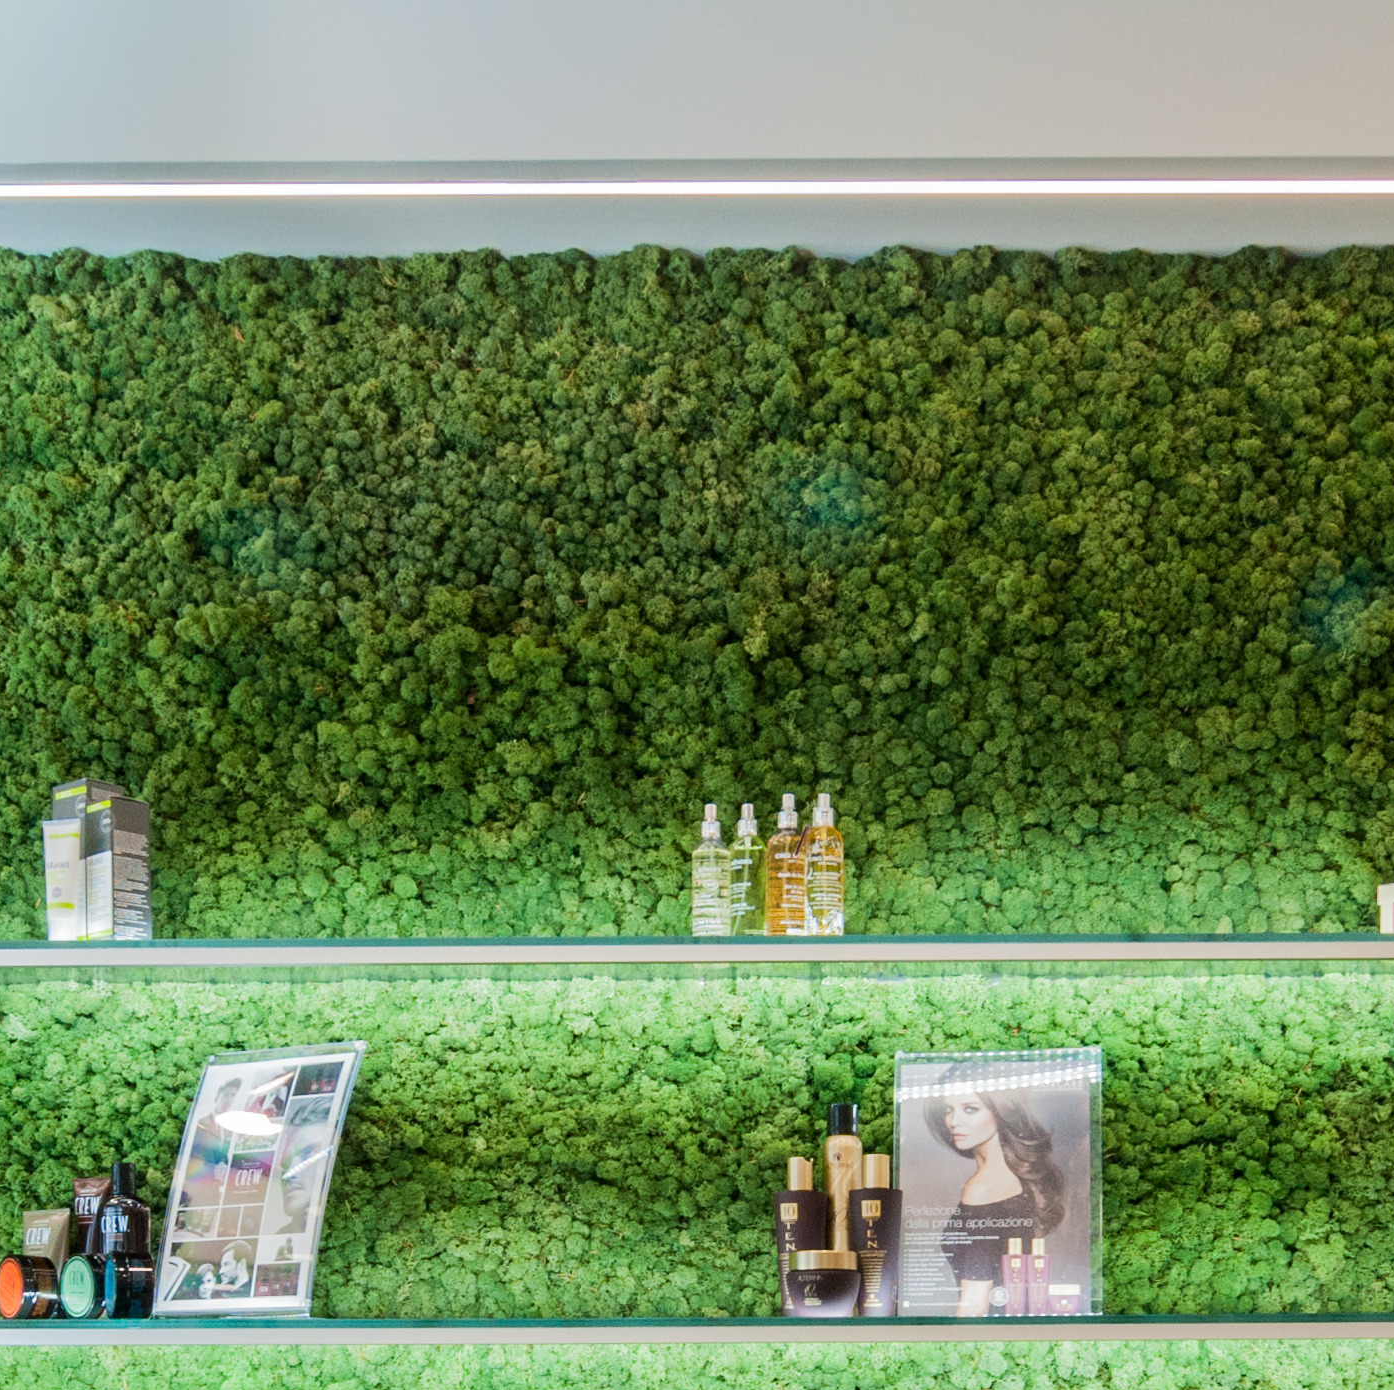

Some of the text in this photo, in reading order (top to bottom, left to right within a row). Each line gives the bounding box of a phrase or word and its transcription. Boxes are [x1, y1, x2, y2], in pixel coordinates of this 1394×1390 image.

[234, 1168, 263, 1188] CREW
[74, 1195, 102, 1215] CREW
[905, 1217, 1033, 1230] dalla prima applicazione
[25, 1227, 51, 1246] CREW
